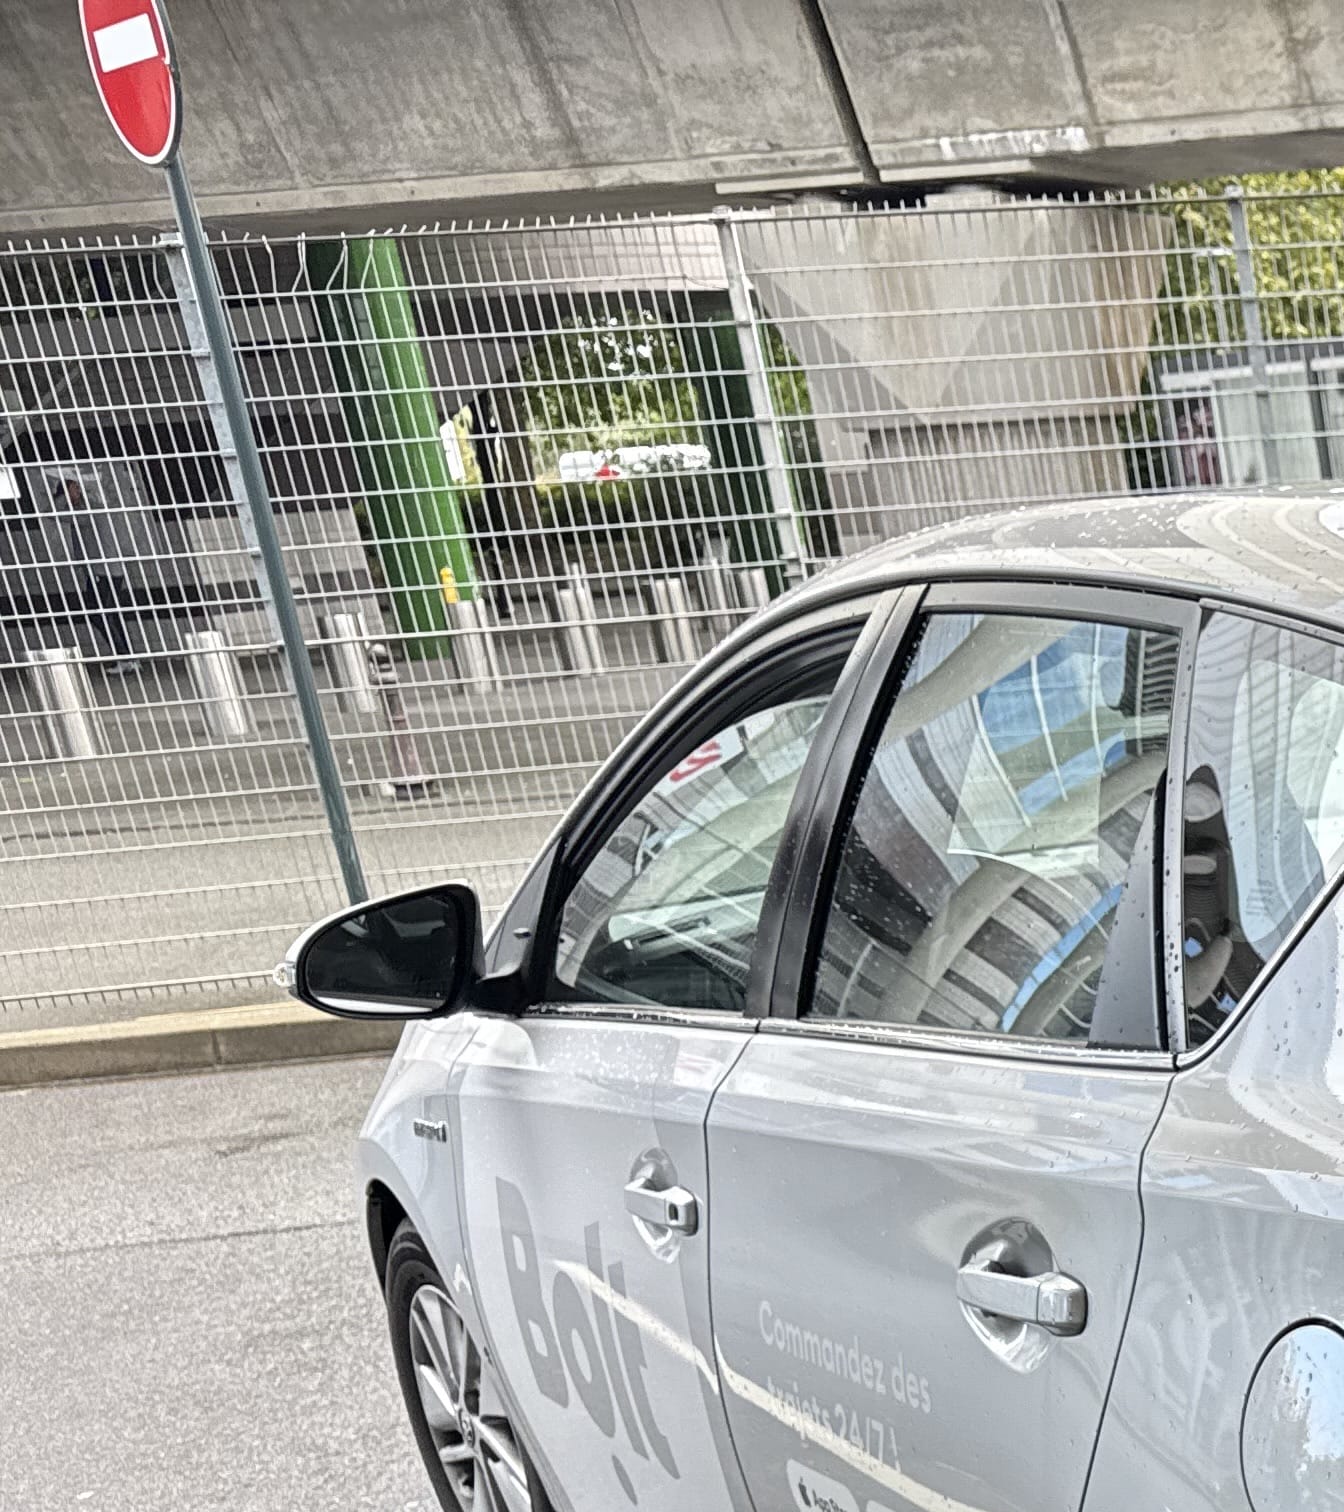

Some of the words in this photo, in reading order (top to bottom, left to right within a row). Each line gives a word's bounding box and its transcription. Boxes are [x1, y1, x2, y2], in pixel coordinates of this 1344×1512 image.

[496, 1176, 680, 1480] Bolt
[759, 1300, 887, 1395] Commandez
[891, 1352, 932, 1414] des
